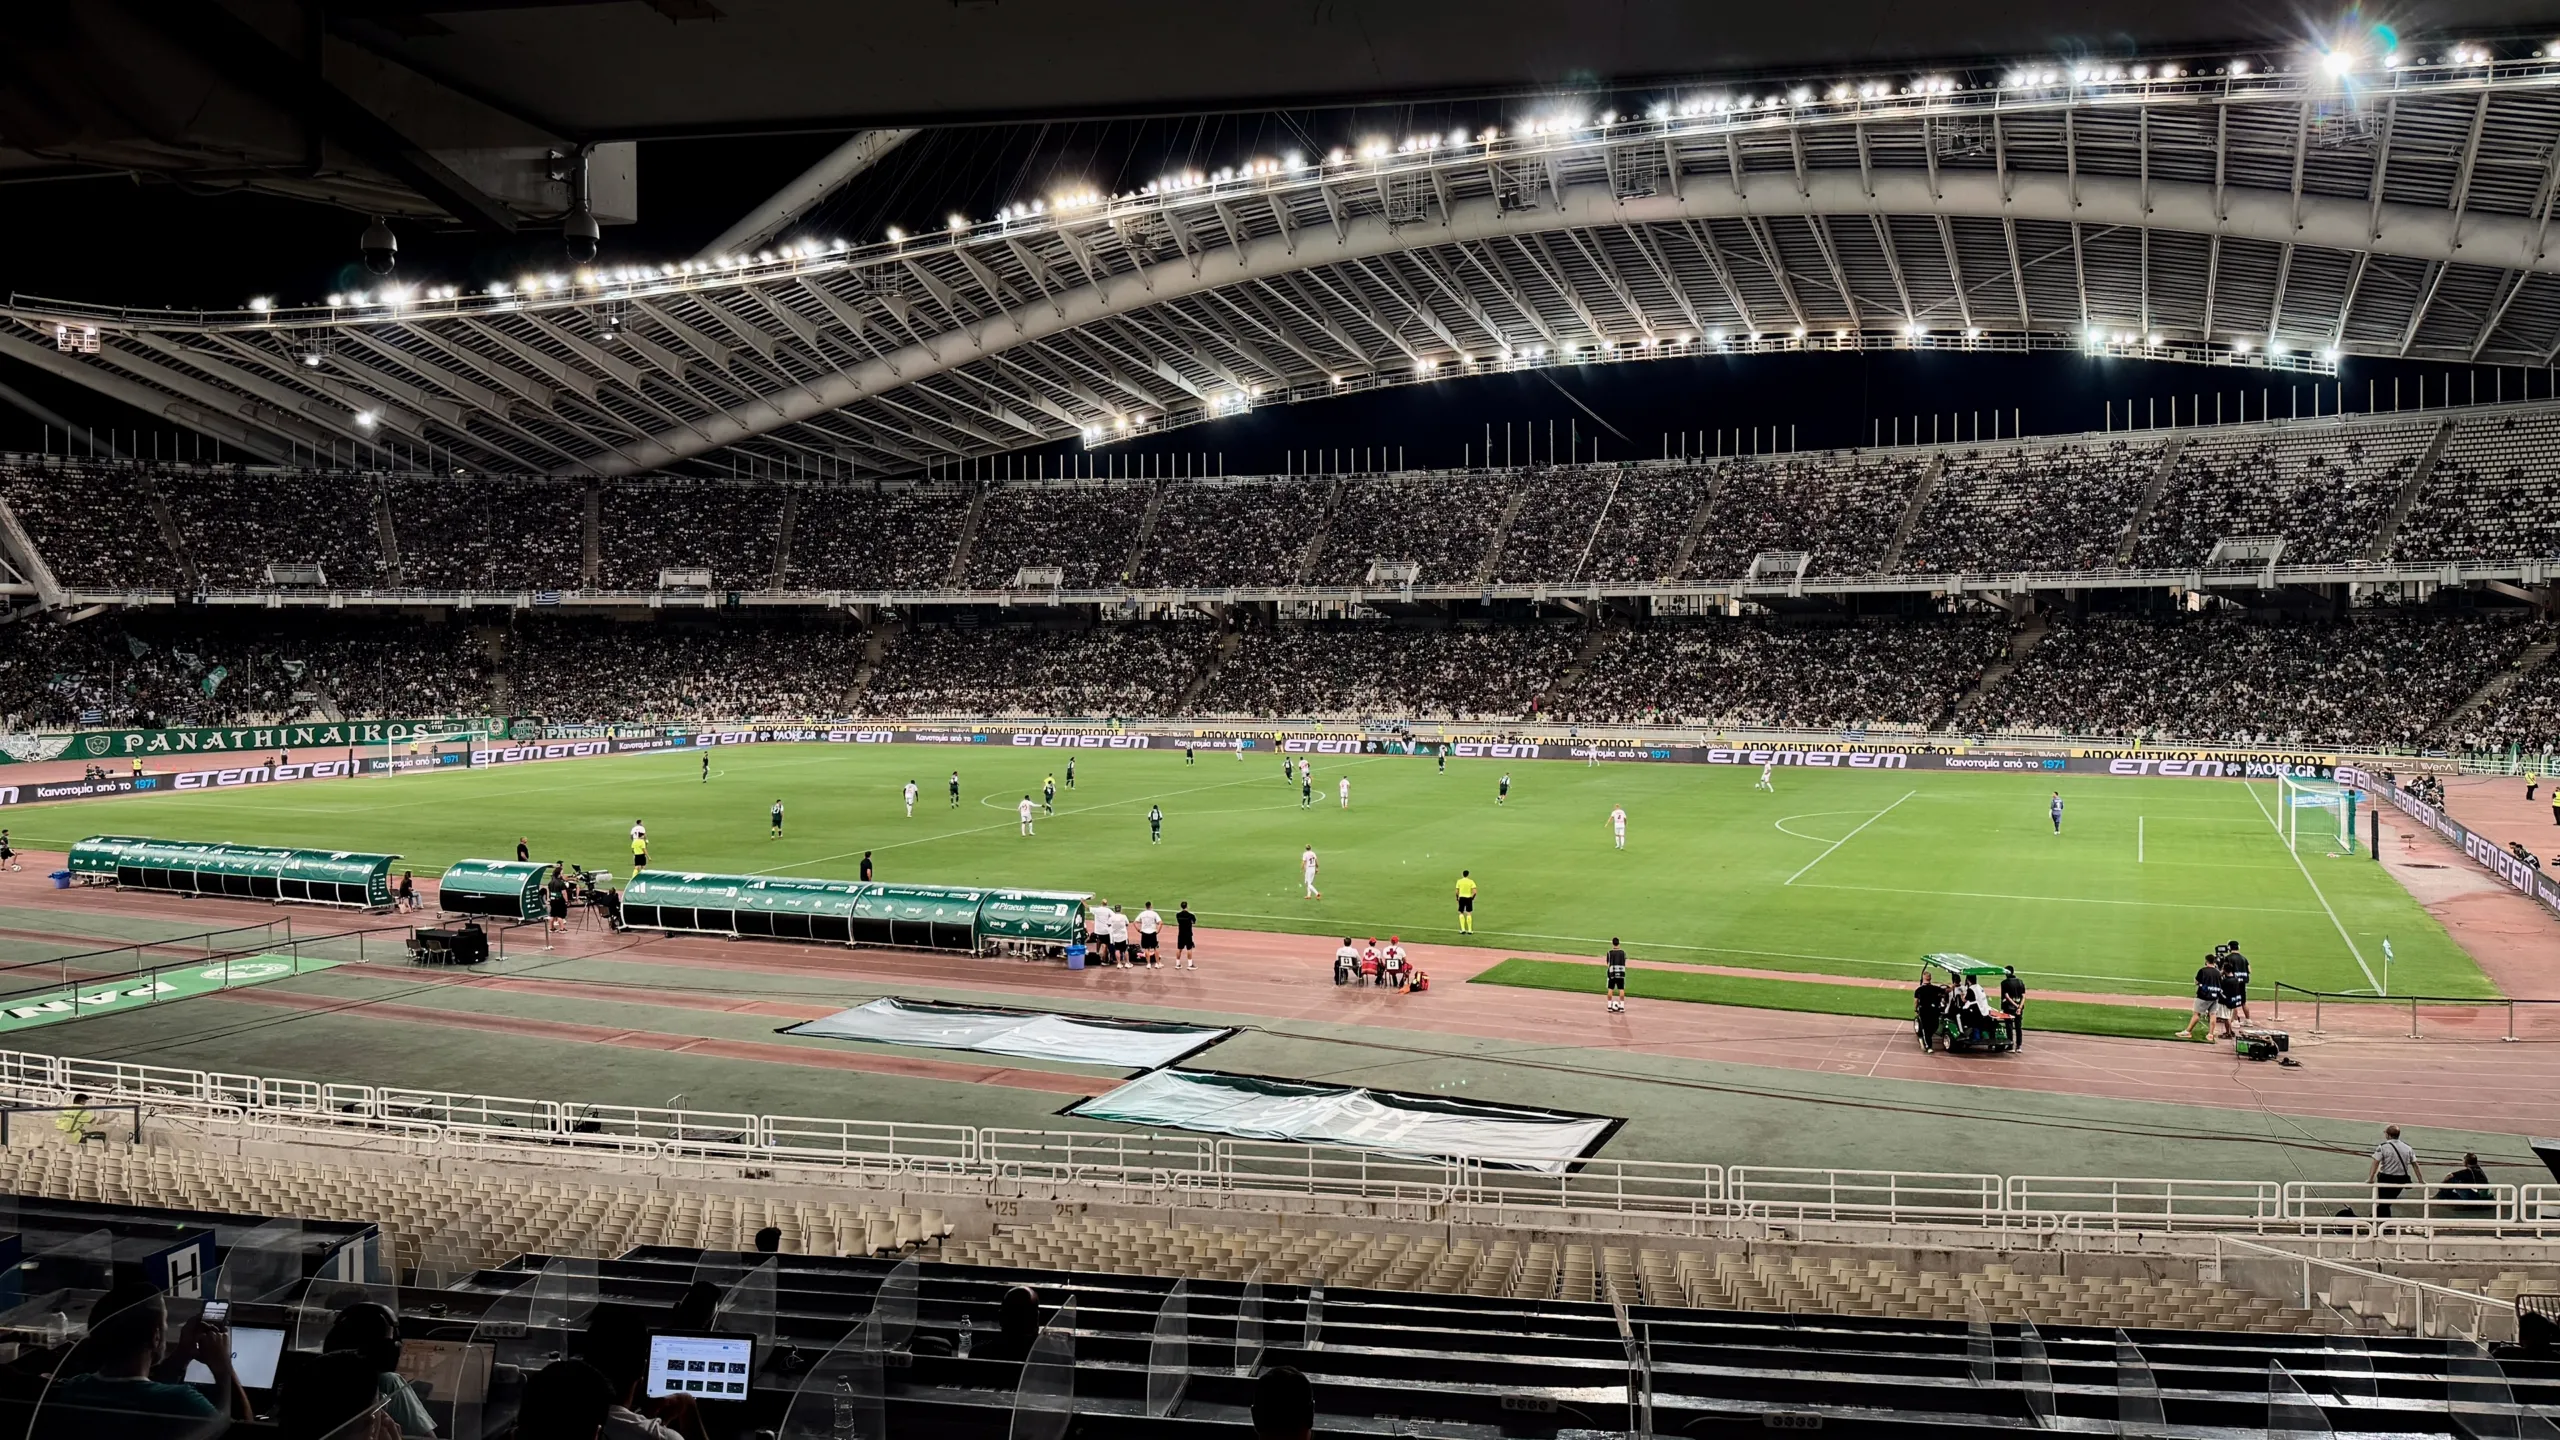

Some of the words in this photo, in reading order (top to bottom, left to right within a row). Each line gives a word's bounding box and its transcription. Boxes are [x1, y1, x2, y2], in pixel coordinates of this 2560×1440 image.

[124, 723, 429, 753] PANATHINAIKOS
[696, 731, 757, 745] ETEM
[828, 731, 893, 743] ETEM
[1012, 734, 1079, 747] ETEM
[1079, 735, 1149, 748] ETEM
[471, 746, 542, 764] ETEM
[545, 741, 610, 758] ETEM
[1284, 739, 1361, 753] ETEM
[1455, 743, 1540, 758] ETEM
[443, 754, 459, 763] 1971
[1651, 750, 1670, 759] 1971
[1707, 749, 1805, 765] ETEM
[1805, 751, 1907, 768] ETEM
[1945, 757, 2000, 769] Καινοτομία
[2003, 758, 2023, 768] από
[2026, 761, 2039, 769] το
[2042, 760, 2065, 769] 1971
[2109, 758, 2225, 777] ETEM
[174, 766, 270, 790] ETEM
[274, 759, 360, 781] ETEM
[38, 783, 93, 798] Καινοτομία
[96, 781, 116, 795] από
[135, 779, 156, 789] 1971
[2465, 831, 2498, 873] ETEM
[2498, 850, 2533, 896] ETEM
[994, 1201, 1017, 1216] 125
